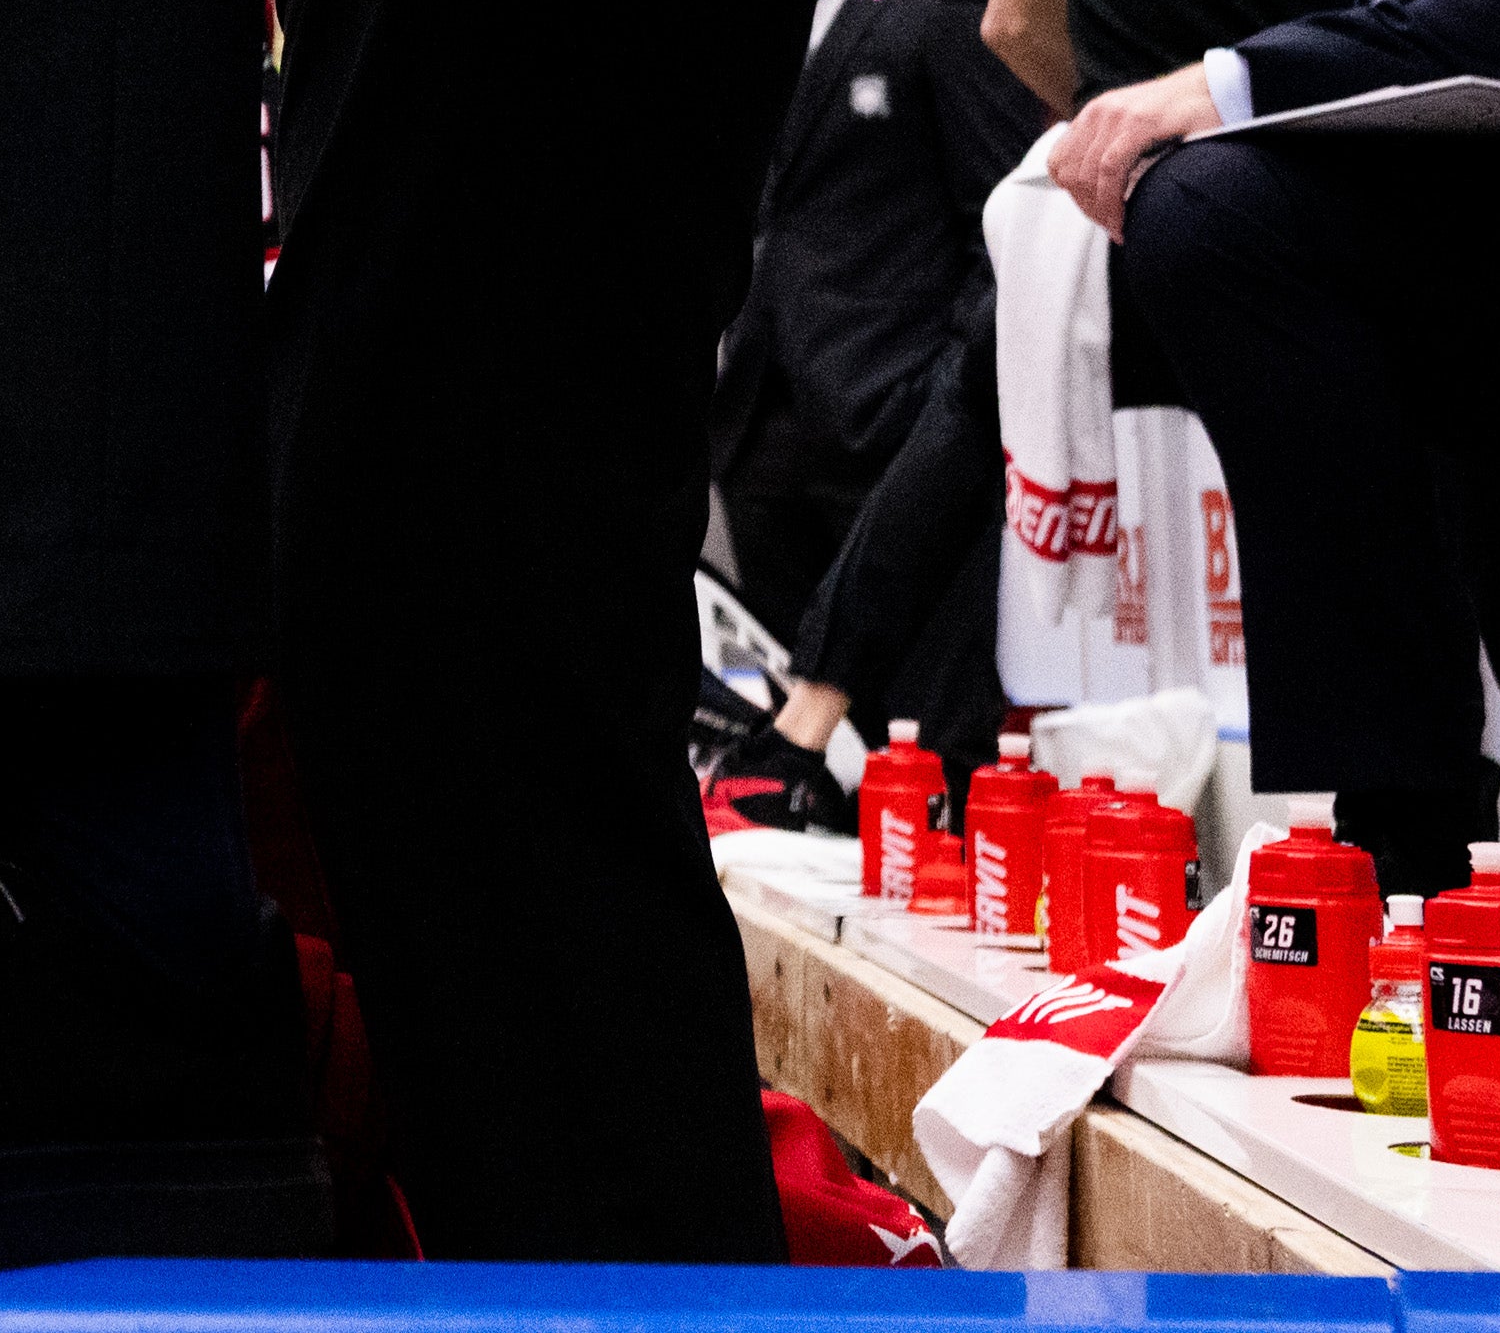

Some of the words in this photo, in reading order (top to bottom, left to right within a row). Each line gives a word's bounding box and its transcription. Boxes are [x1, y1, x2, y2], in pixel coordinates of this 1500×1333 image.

[1262, 914, 1297, 948] 26
[1451, 977, 1484, 1016] 16
[1448, 1017, 1493, 1034] LASSEN
